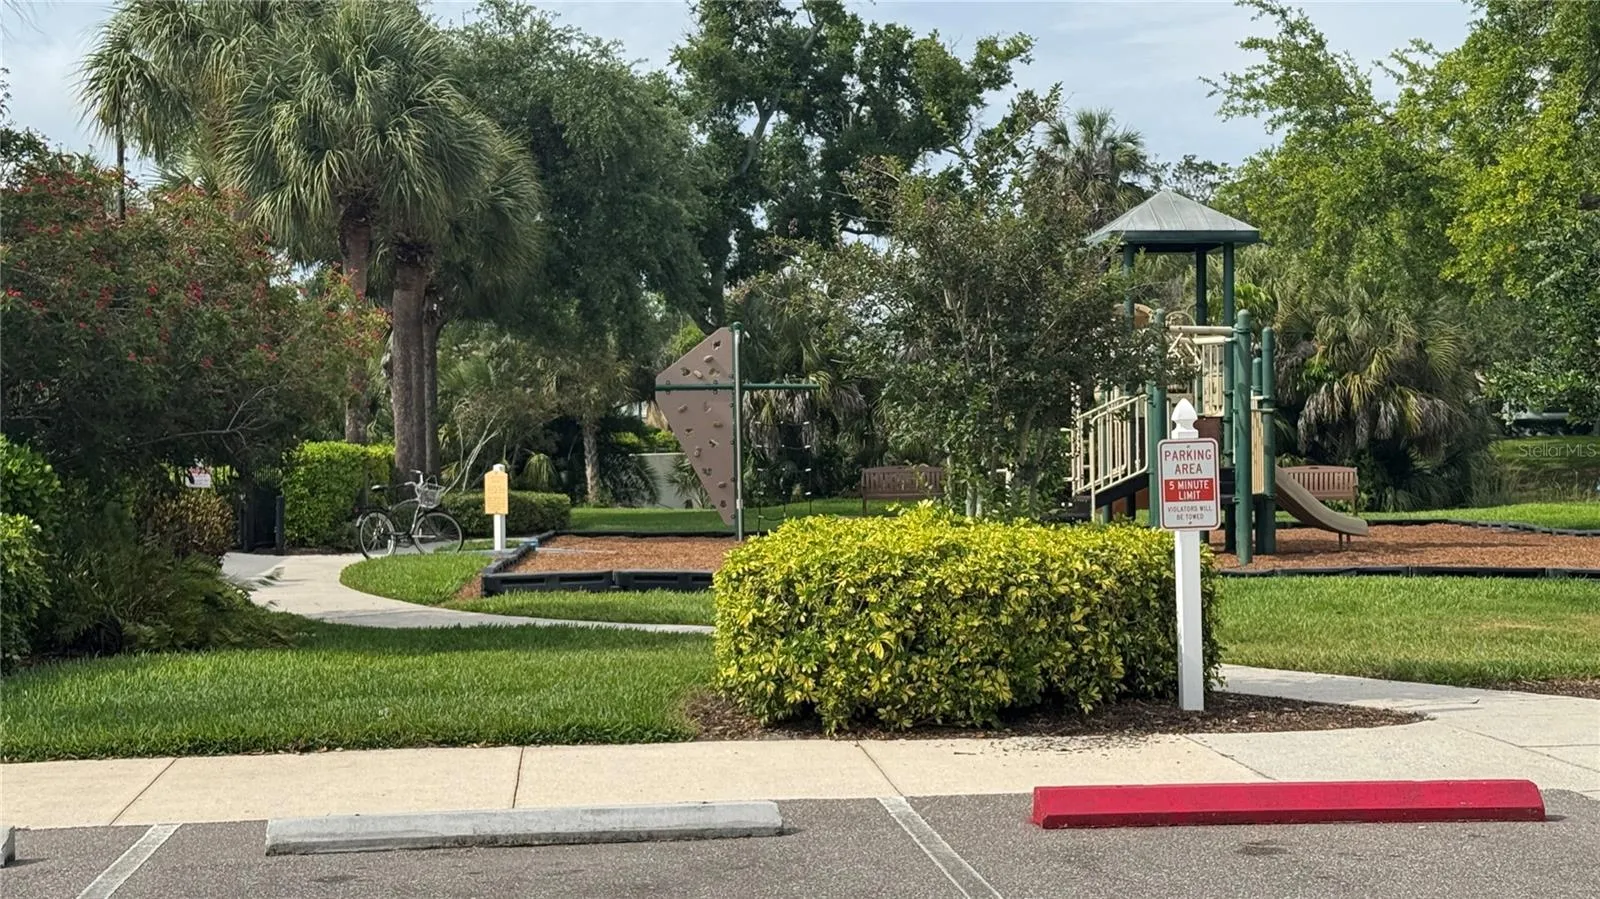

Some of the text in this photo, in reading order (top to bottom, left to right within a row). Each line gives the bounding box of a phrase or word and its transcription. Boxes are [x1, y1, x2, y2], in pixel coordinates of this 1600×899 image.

[1164, 449, 1212, 461] PARKING
[1174, 463, 1203, 475] AREA
[1169, 479, 1209, 490] 5 MINUTE
[1178, 490, 1201, 500] LIMIT
[1167, 505, 1198, 513] VIOLATORS
